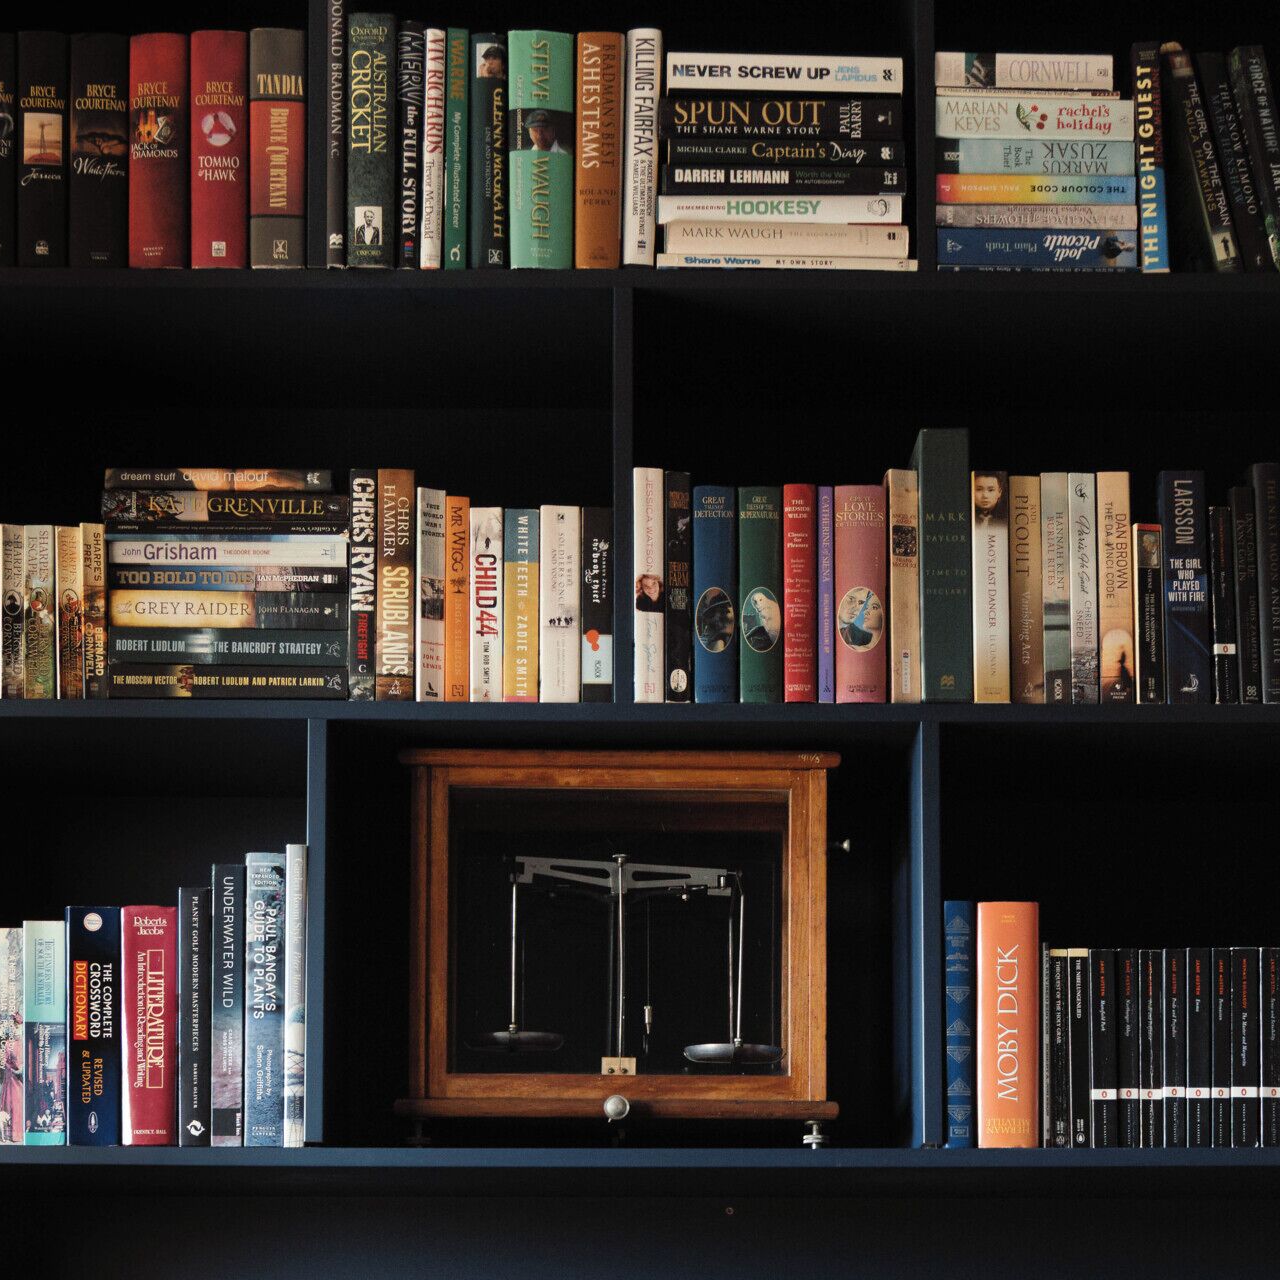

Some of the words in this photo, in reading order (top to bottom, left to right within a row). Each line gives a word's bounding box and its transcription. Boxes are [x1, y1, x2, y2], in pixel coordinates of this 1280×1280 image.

[428, 32, 444, 65] VIV
[634, 38, 655, 91] KILLING
[206, 81, 233, 93] BRYCE
[257, 74, 303, 96] TANDIA
[531, 40, 550, 102] STEVE
[581, 43, 601, 101] ASHES
[672, 64, 731, 78] NEVER
[738, 66, 802, 79] SCREW
[807, 67, 830, 79] UP
[195, 95, 244, 106] COURTENAY
[351, 50, 371, 154] CRICKET
[374, 50, 387, 152] AUSTRALIAN
[406, 106, 418, 126] the
[426, 69, 444, 154] RICHARDS
[674, 101, 750, 125] SPUN
[762, 101, 825, 125] OUT
[1058, 104, 1110, 117] rachel's
[1136, 66, 1155, 138] GUEST
[581, 101, 601, 168] TEAMS
[633, 96, 654, 156] FAIRFAX
[703, 126, 738, 134] SHANE
[744, 126, 781, 134] WARNE
[1057, 117, 1112, 134] holiday
[199, 156, 240, 168] TOMMO
[402, 128, 418, 171] FULL
[752, 142, 825, 163] Captain's
[830, 142, 866, 163] Diary
[204, 170, 236, 181] HAWK
[675, 169, 725, 183] DARREN
[730, 170, 789, 184] LEHMANN
[1139, 143, 1157, 217] NIGHT
[401, 175, 416, 239] STORY
[531, 157, 550, 240] WAUGH
[726, 200, 820, 215] HOOKESY
[1142, 225, 1159, 265] THE
[207, 497, 325, 517] GRENVILLE
[352, 477, 376, 542] CHRIS
[1115, 513, 1127, 538] DAN
[1174, 480, 1194, 544] LARSSON
[122, 548, 141, 557] John
[144, 543, 217, 560] Grisham
[518, 515, 529, 555] WHITE
[117, 571, 150, 584] TOO
[153, 571, 197, 584] BOLD
[201, 571, 222, 584] TO
[225, 571, 255, 584] DIE
[351, 547, 375, 611] RYAN
[475, 554, 497, 607] CHILD
[518, 561, 529, 598] TEETH
[1115, 542, 1128, 590] BROWN
[1170, 559, 1186, 569] THE
[1188, 559, 1202, 569] GIRL
[1177, 570, 1194, 580] WHO
[1168, 591, 1187, 602] WITH
[1189, 591, 1205, 602] FIRE
[1173, 581, 1200, 591] PLAYED
[134, 602, 179, 615] GREY
[185, 602, 251, 616] RAIDER
[382, 566, 409, 675] SCRUBLANDS
[475, 610, 498, 637] 44
[116, 639, 148, 651] ROBERT
[151, 640, 185, 651] LUDLUM
[213, 641, 229, 653] THE
[231, 642, 276, 654] BANCROFT
[279, 642, 321, 655] STRATEGY
[517, 616, 528, 653] ZADIE
[516, 657, 528, 697] SMITH
[223, 876, 234, 970] UNDERWATER
[254, 901, 265, 942] GUIDE
[266, 908, 276, 940] PAUL
[103, 963, 112, 983] THE
[254, 952, 264, 967] TO
[266, 943, 276, 1012] BANGAY'S
[222, 975, 233, 1008] WILD
[253, 972, 264, 1019] PLANTS
[997, 943, 1019, 1015] DICK
[75, 962, 86, 1039] DICTIONARY
[90, 963, 101, 1038] CROSSWORD
[103, 986, 112, 1038] COMPLETE
[146, 971, 164, 1069] LITERATURE
[997, 1022, 1018, 1102] MOBY
